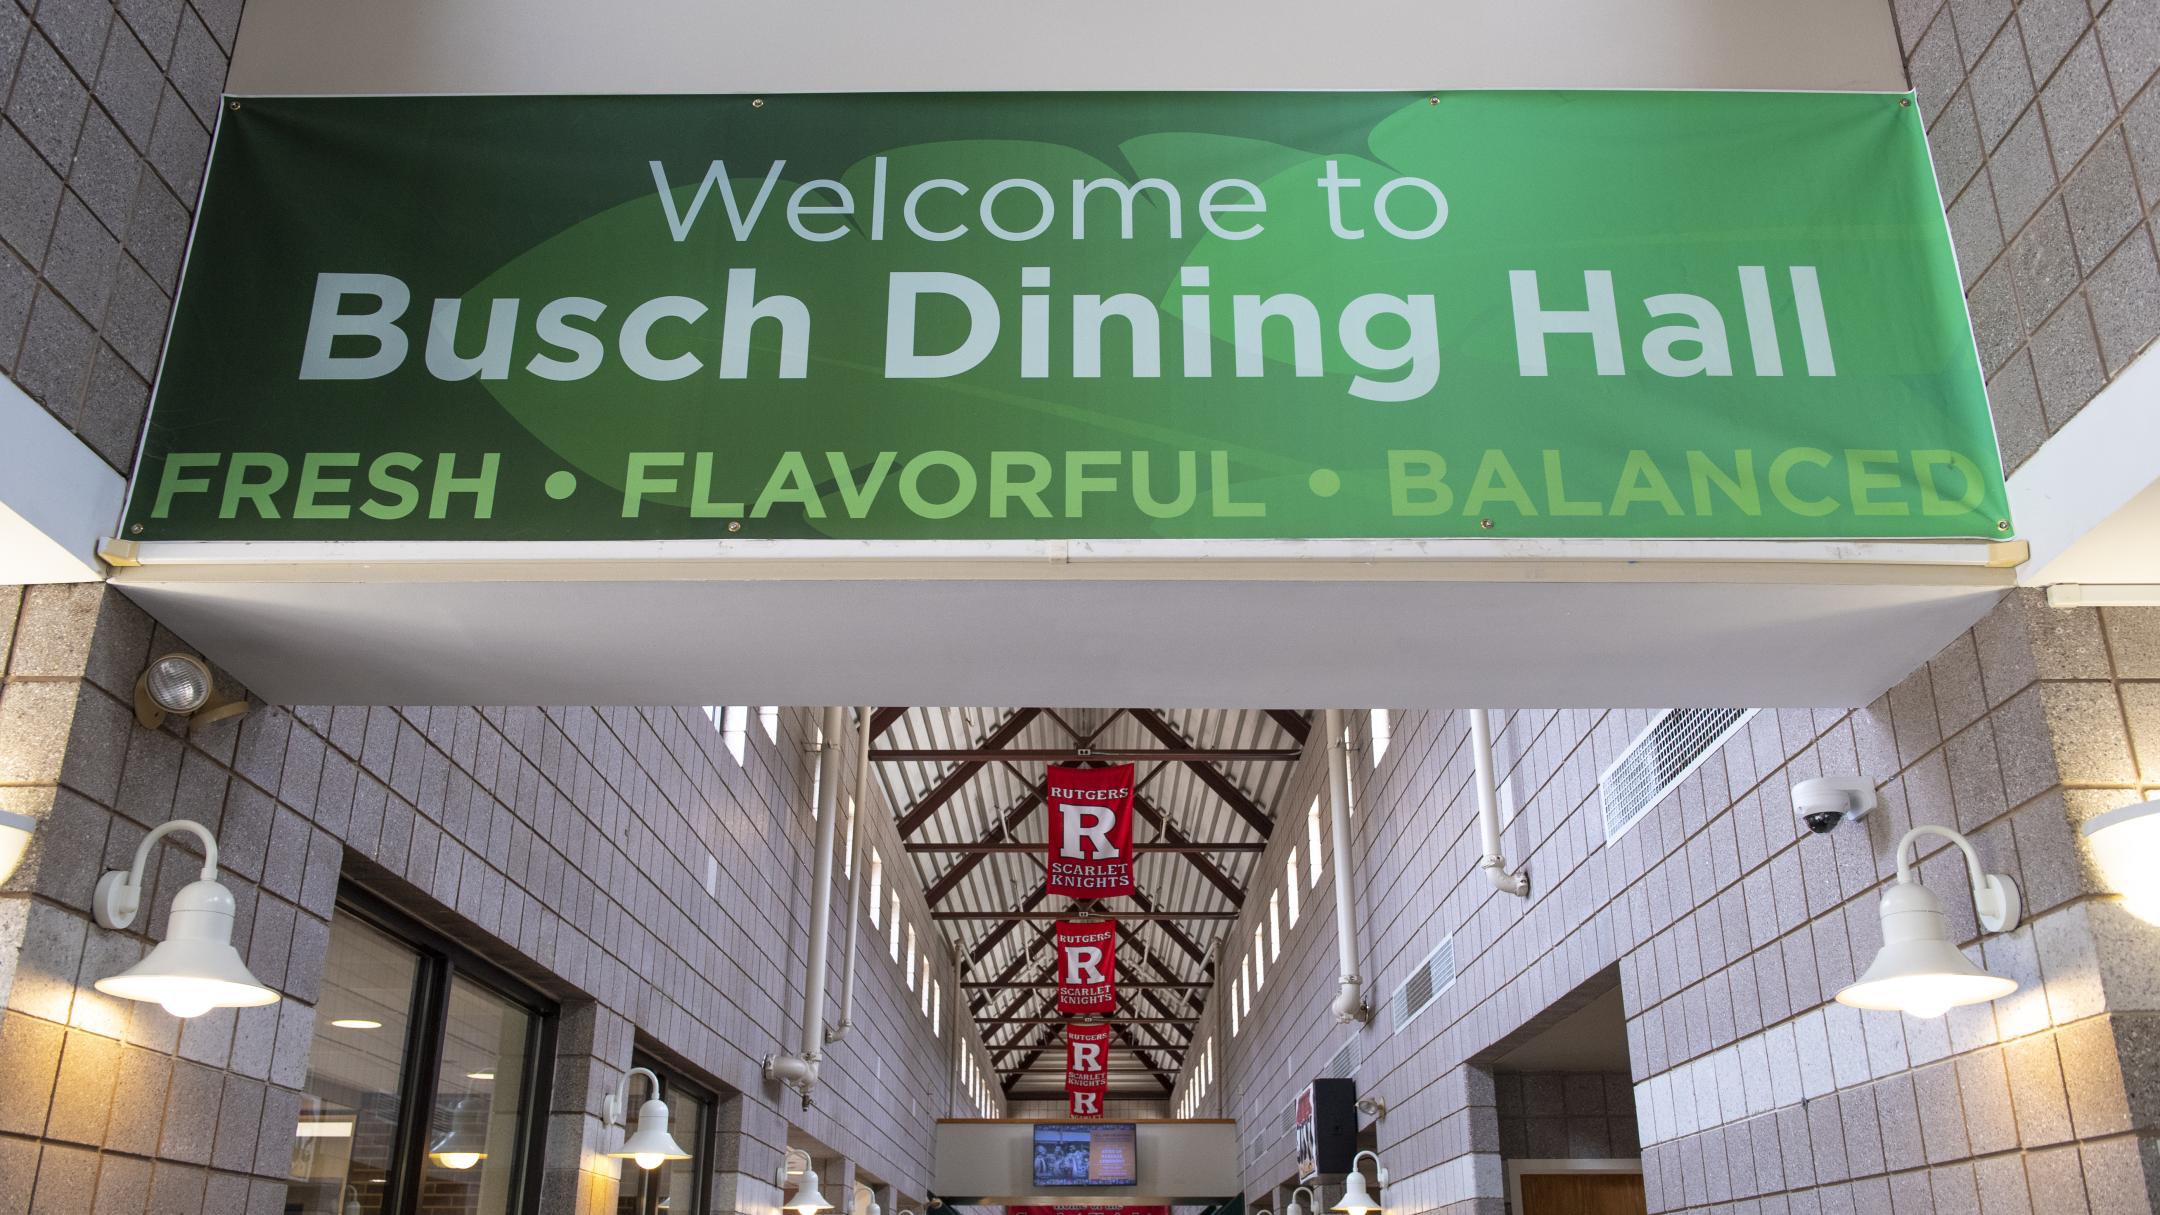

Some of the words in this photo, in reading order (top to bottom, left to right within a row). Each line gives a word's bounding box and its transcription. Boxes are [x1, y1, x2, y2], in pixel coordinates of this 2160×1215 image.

[650, 156, 1266, 242] Welcome
[1317, 159, 1449, 241] to
[298, 267, 811, 382] Busch
[884, 265, 1441, 402] Dining
[1508, 265, 1837, 379] Hall
[151, 451, 500, 519] FRESH
[621, 450, 1266, 519] FLAVORFUL
[1388, 446, 1986, 517] BALANCED
[1051, 787, 1129, 800] RUTGERS
[1059, 803, 1120, 860] R
[1052, 863, 1128, 876] SCARLET
[1051, 875, 1130, 888] KNIGHTS
[1060, 931, 1112, 943] RUTGERS
[1064, 946, 1106, 985] R
[1060, 985, 1111, 996] SCARLET
[1060, 994, 1112, 1005] KNIGHTS
[1068, 1032, 1108, 1041] RUTGERS
[1072, 1042, 1102, 1072] R
[1068, 1072, 1106, 1081] SCARLET
[1068, 1079, 1106, 1087] KNIGHTS
[1073, 1091, 1099, 1114] R
